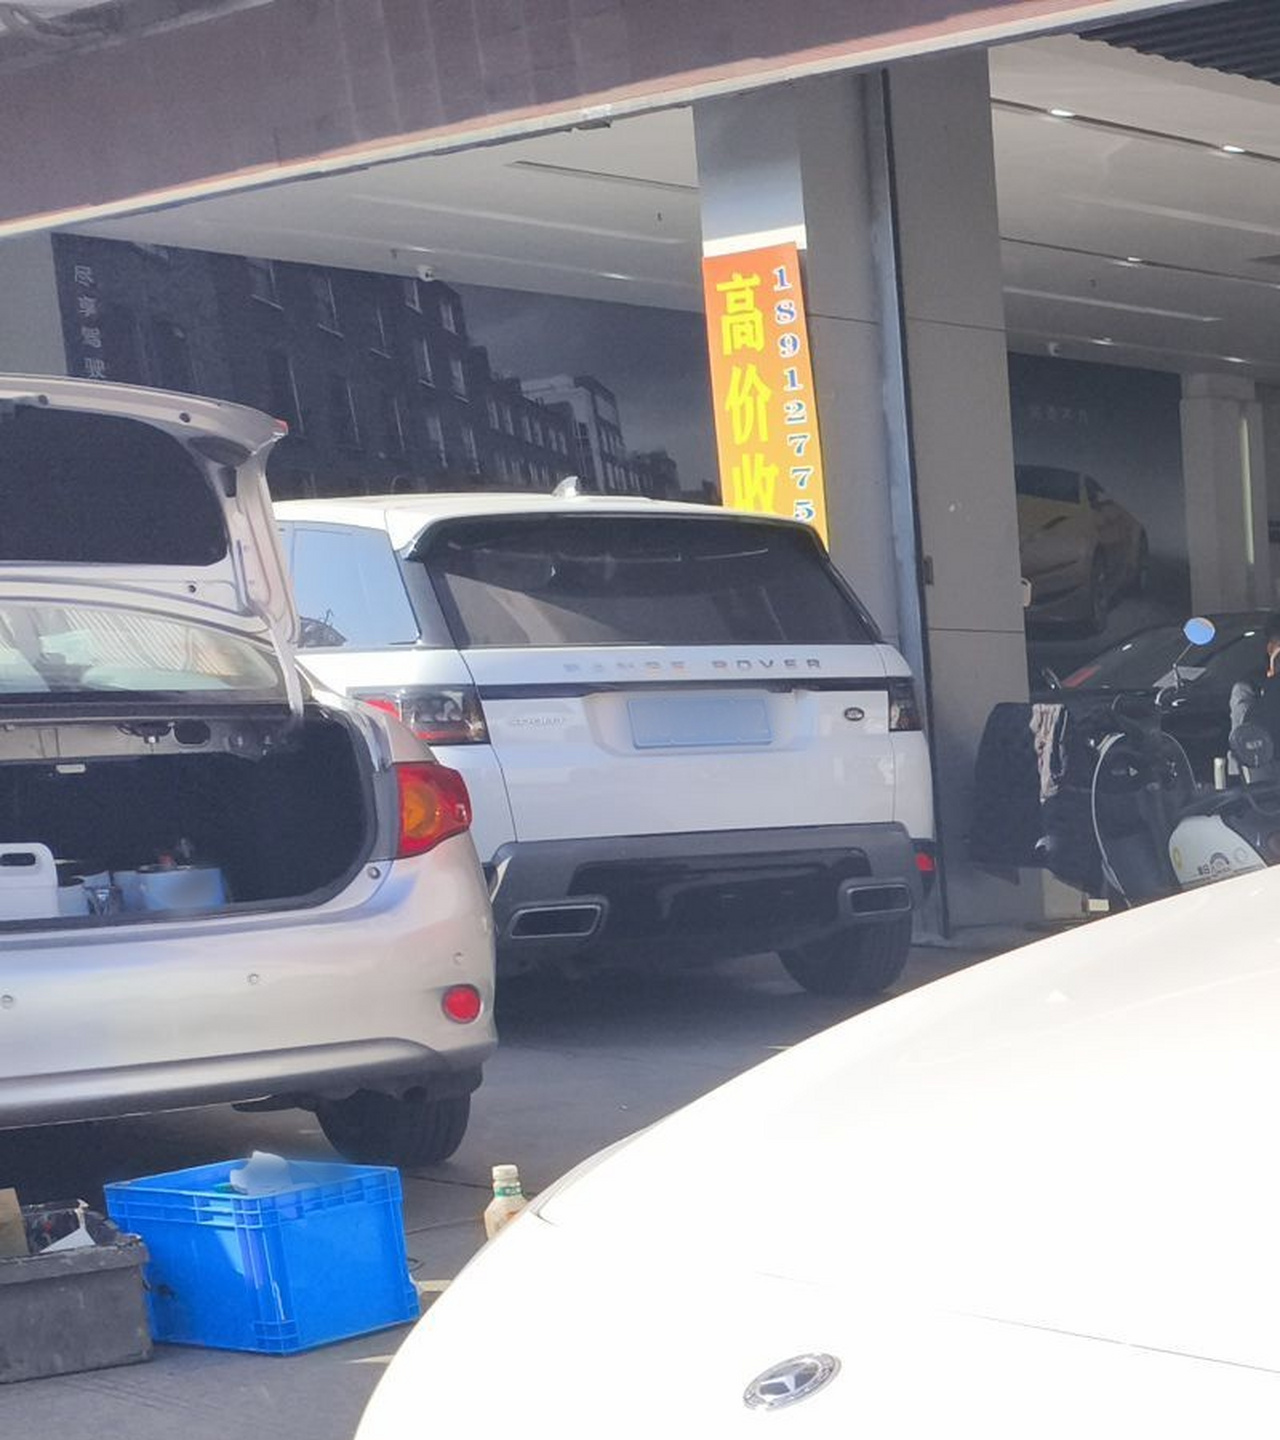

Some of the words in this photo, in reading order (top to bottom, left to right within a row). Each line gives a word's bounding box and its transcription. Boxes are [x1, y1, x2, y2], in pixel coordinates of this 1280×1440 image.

[716, 271, 780, 515] 高价收
[711, 657, 821, 671] ROVER
